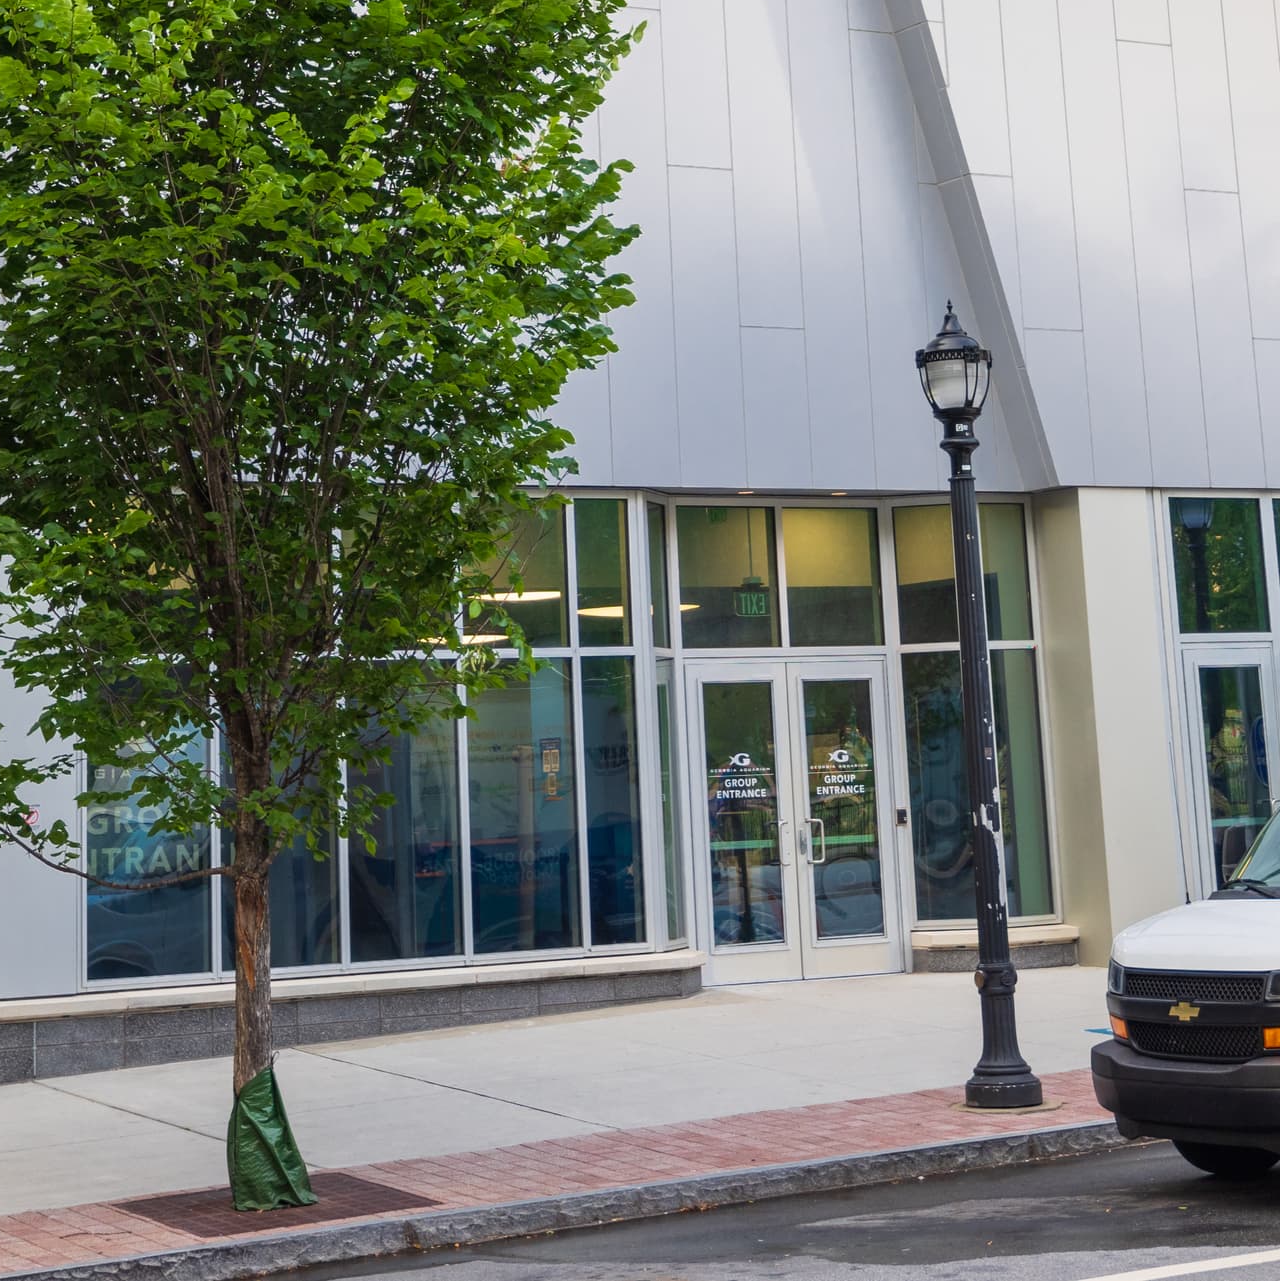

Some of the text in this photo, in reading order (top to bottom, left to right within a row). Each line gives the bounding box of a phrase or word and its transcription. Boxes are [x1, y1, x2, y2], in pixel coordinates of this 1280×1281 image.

[724, 778, 757, 787] GROUP
[824, 774, 856, 784] GROUP
[716, 789, 767, 799] ENTRANCE
[816, 784, 865, 795] ENTRANCE
